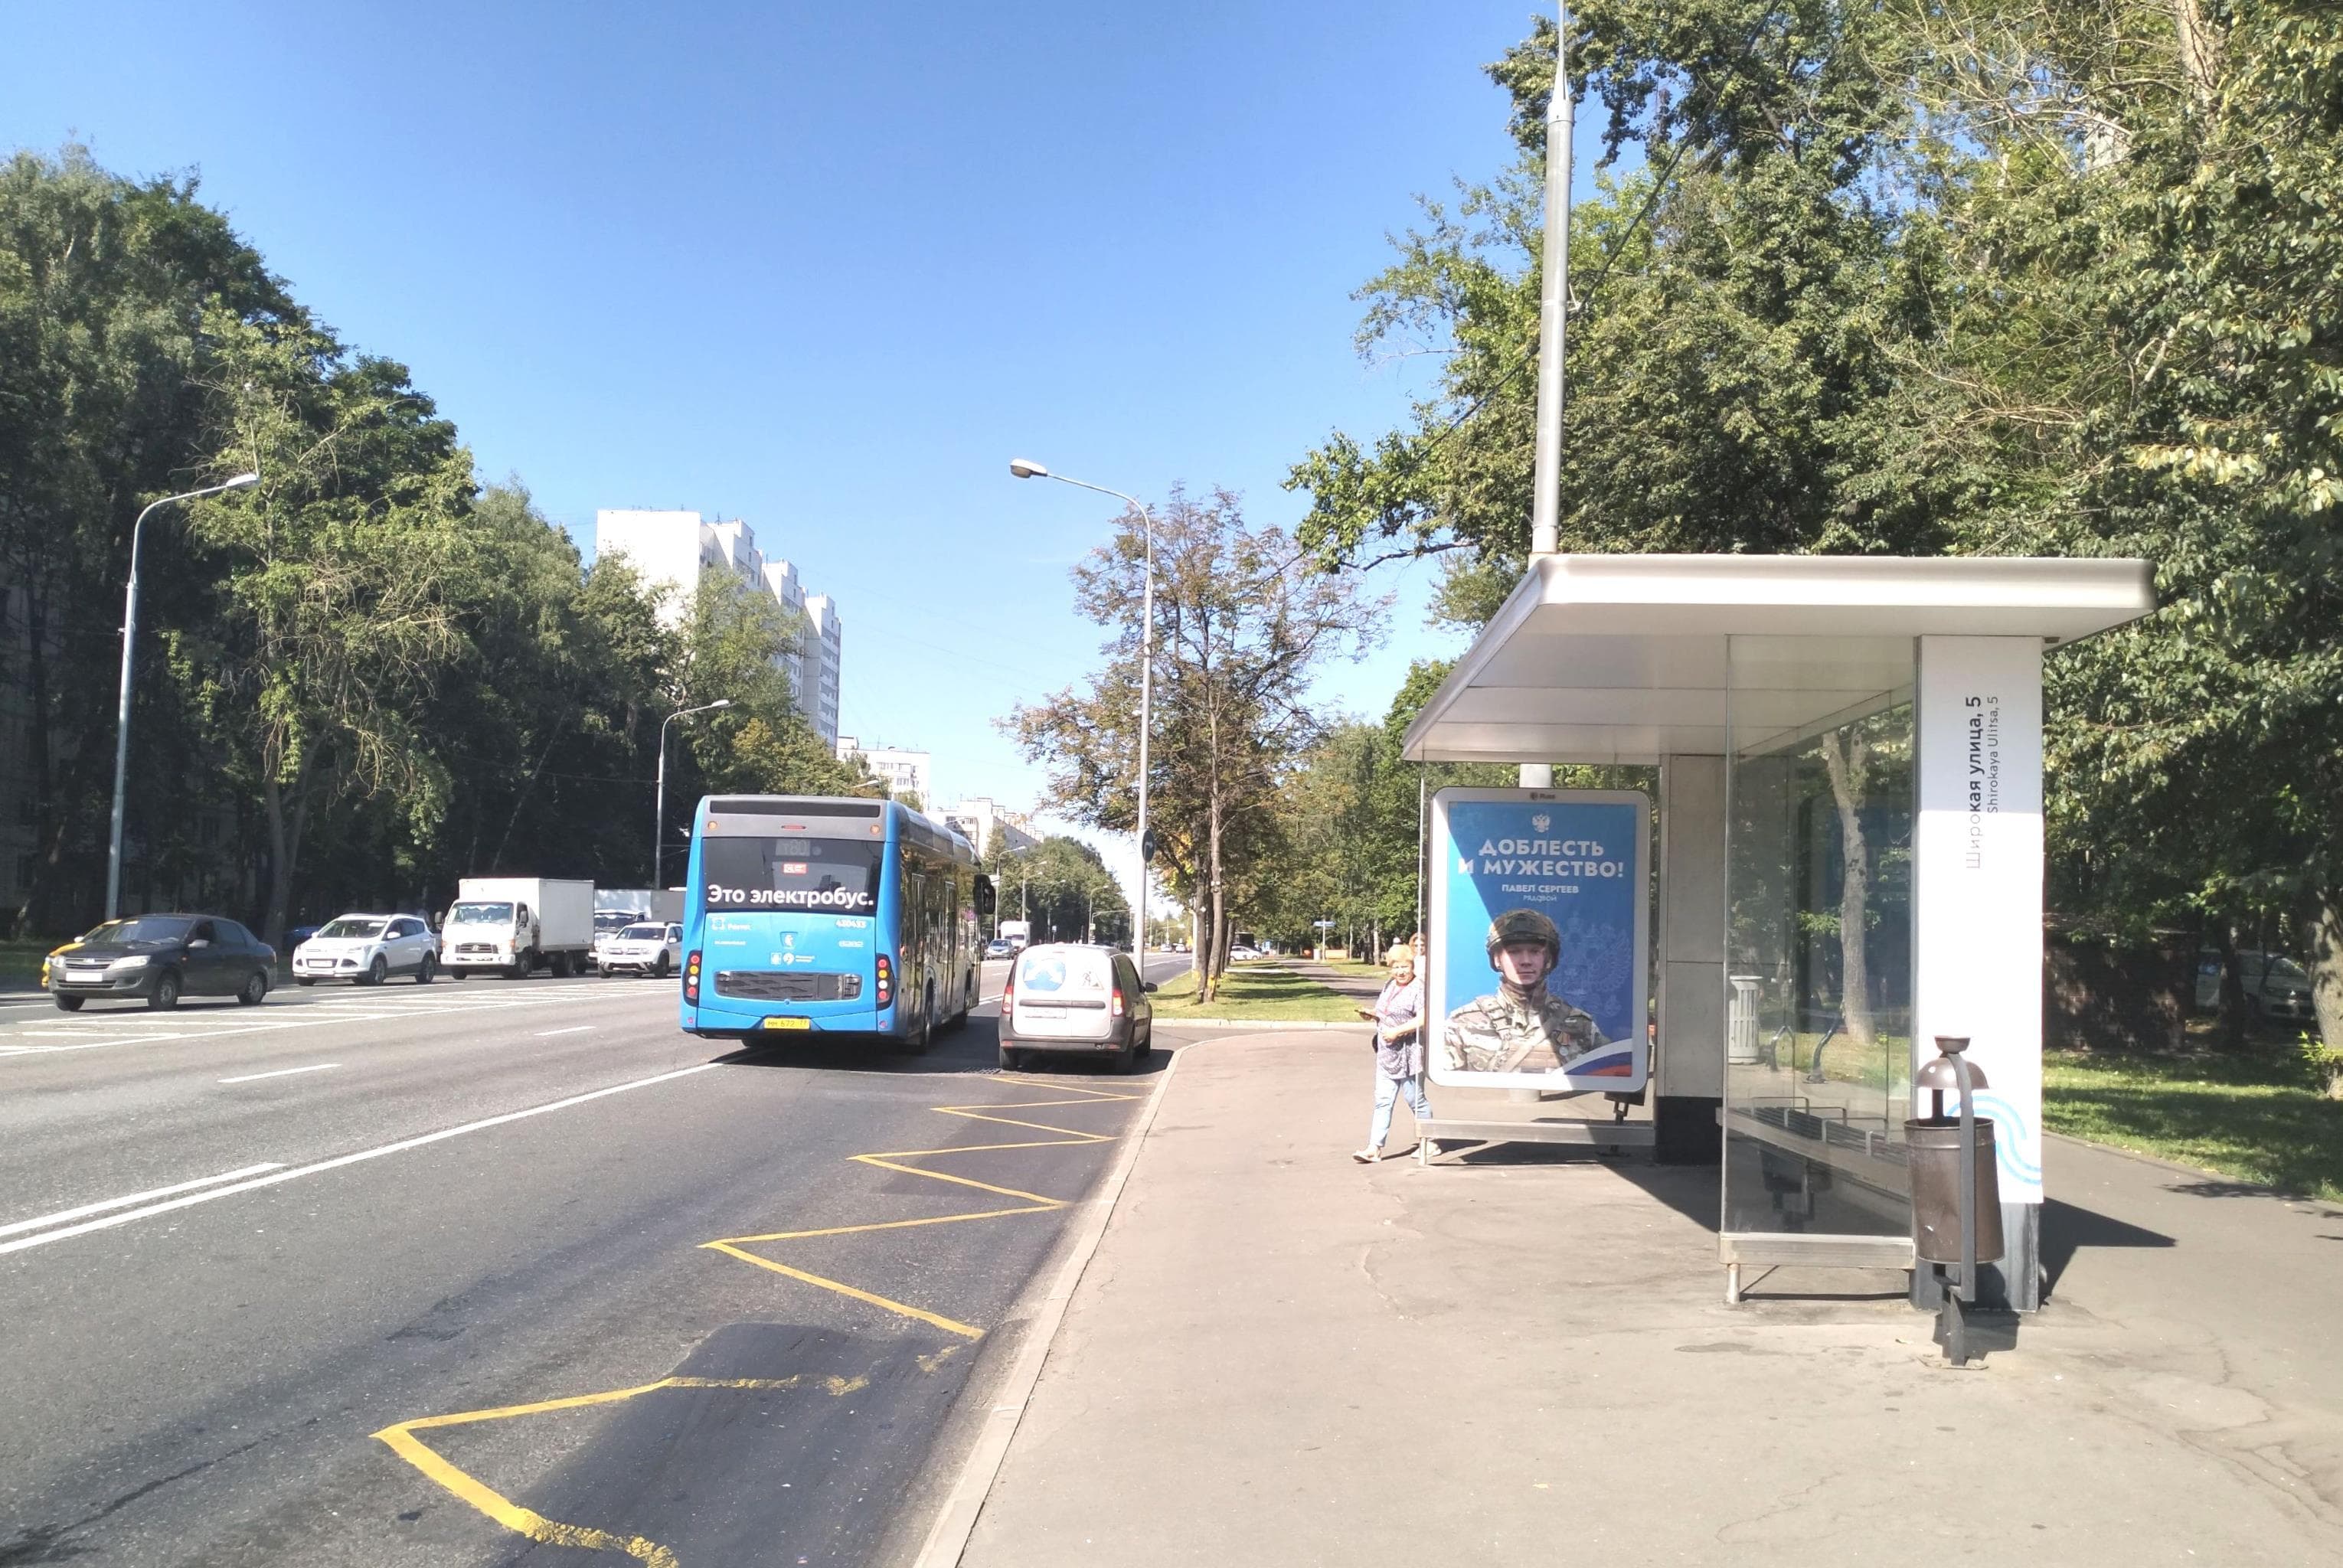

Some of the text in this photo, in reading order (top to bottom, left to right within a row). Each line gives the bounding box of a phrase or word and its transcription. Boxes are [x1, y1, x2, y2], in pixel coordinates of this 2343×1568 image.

[1987, 707, 1999, 746] Ulitsa,
[1966, 696, 1985, 869] Широкая улица, 5
[1987, 751, 2000, 813] Shirokaya
[1479, 839, 1604, 856] ДОБЛЕСТЬ
[1458, 858, 1624, 877] И МУЖЕСТВО!
[707, 884, 874, 909] Это электробус.
[1538, 885, 1579, 893] СЕРГЕЕВ
